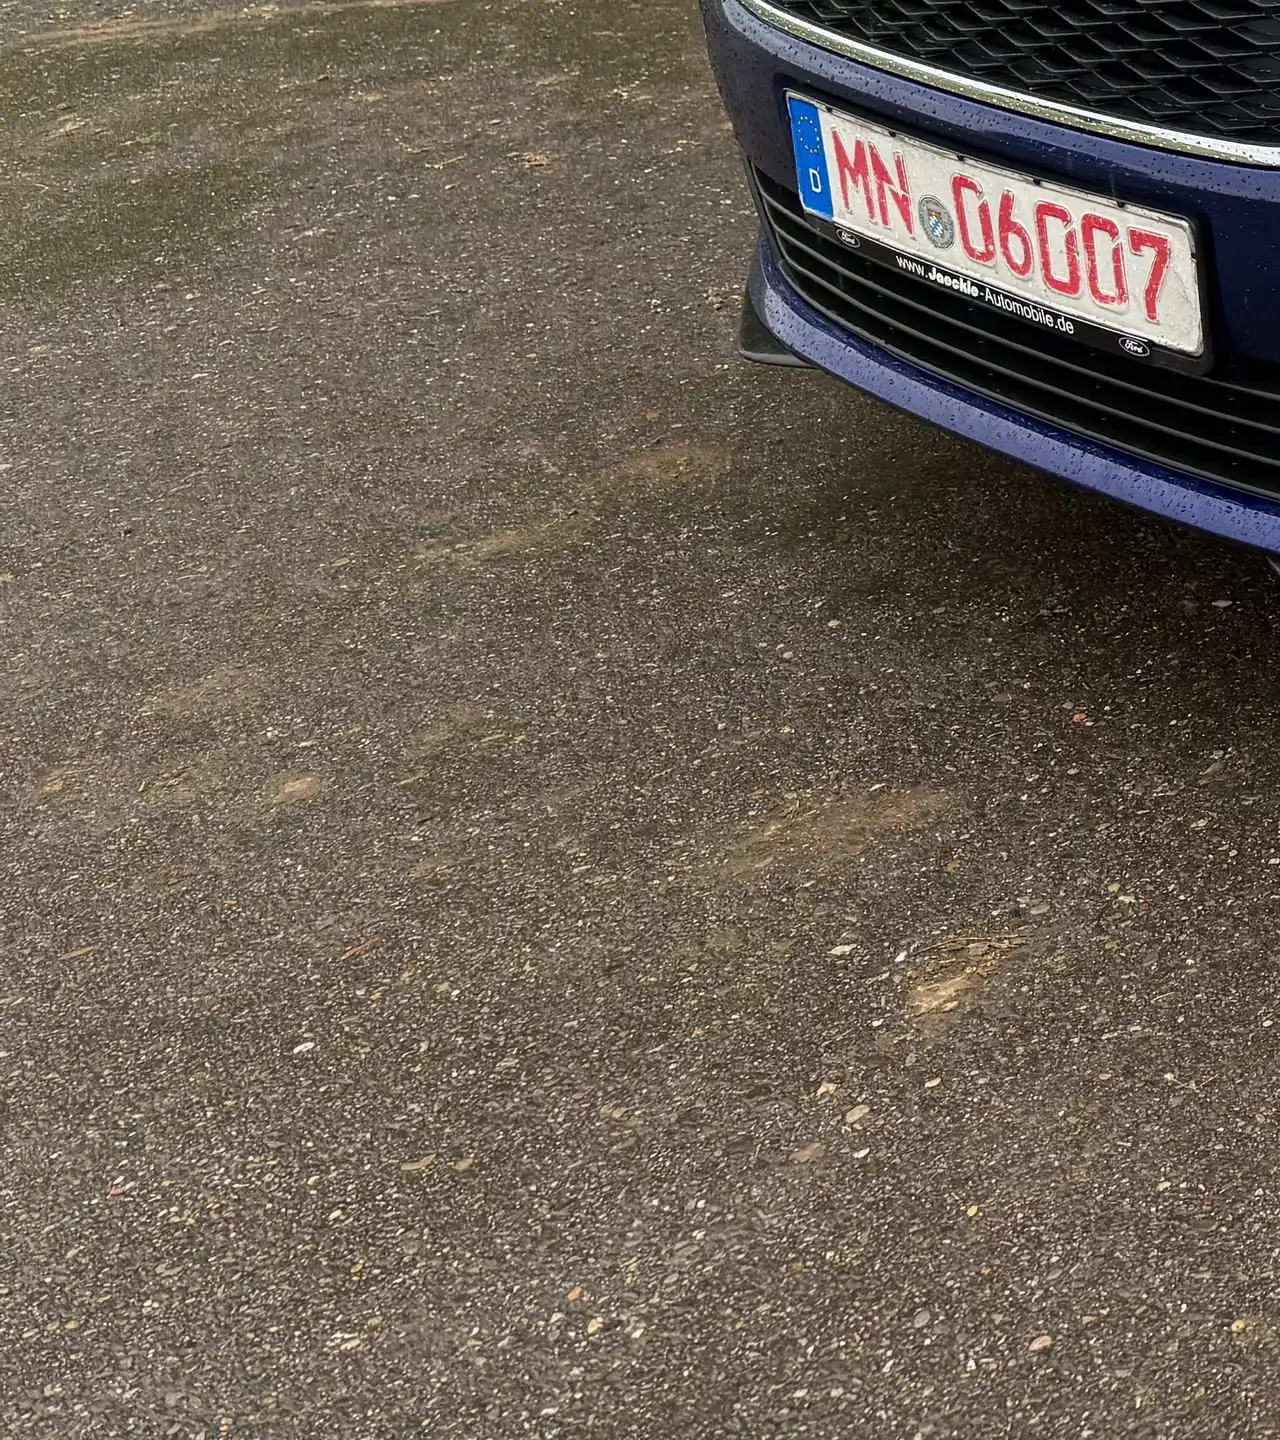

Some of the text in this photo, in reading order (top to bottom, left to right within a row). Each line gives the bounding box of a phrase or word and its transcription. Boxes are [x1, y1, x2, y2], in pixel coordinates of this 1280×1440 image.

[809, 167, 821, 193] D
[831, 127, 915, 239] MN
[951, 173, 1171, 322] 06007
[896, 255, 1075, 335] www.Jaeckle-Automobile.de
[1125, 339, 1144, 353] Ford
